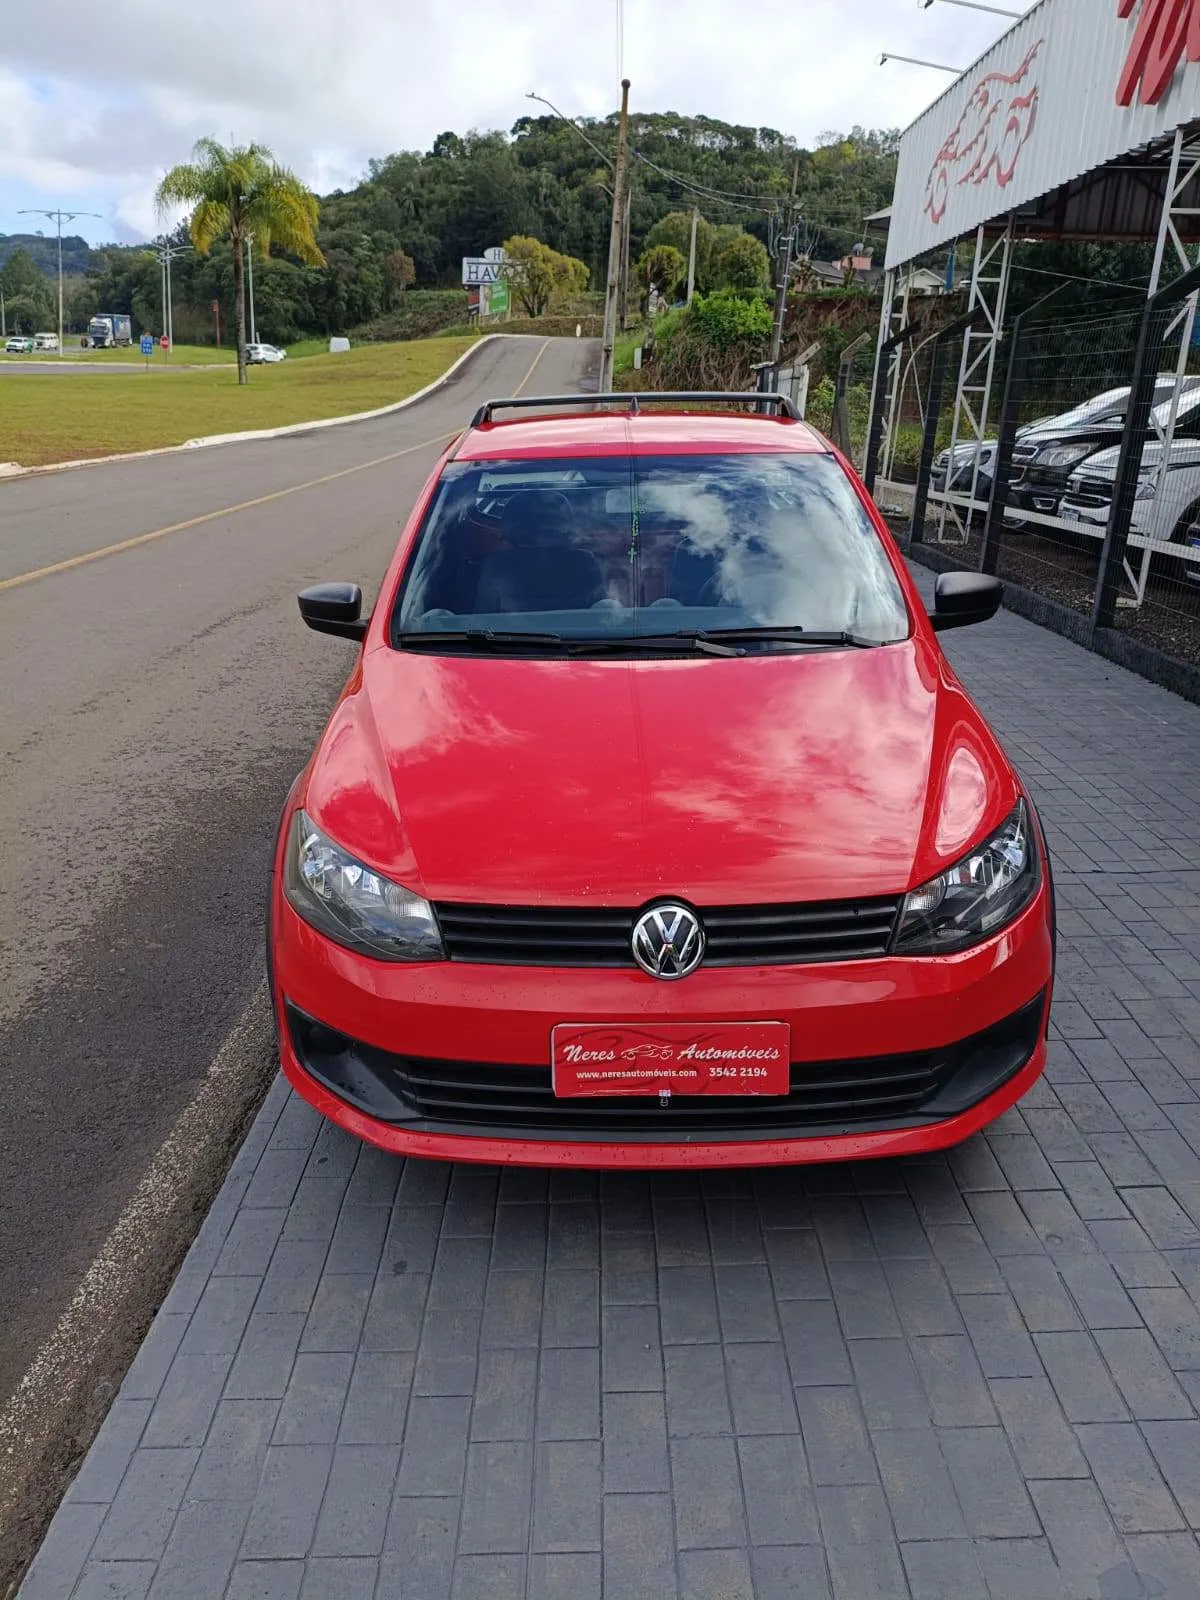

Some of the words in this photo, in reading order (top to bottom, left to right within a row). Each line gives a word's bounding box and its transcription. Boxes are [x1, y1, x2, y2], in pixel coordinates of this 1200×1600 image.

[563, 1044, 616, 1062] Neres
[676, 1043, 780, 1060] Automóveis
[576, 1068, 697, 1079] www.neresautomóveis.com
[709, 1067, 737, 1077] 3542
[740, 1067, 767, 1077] 2194
